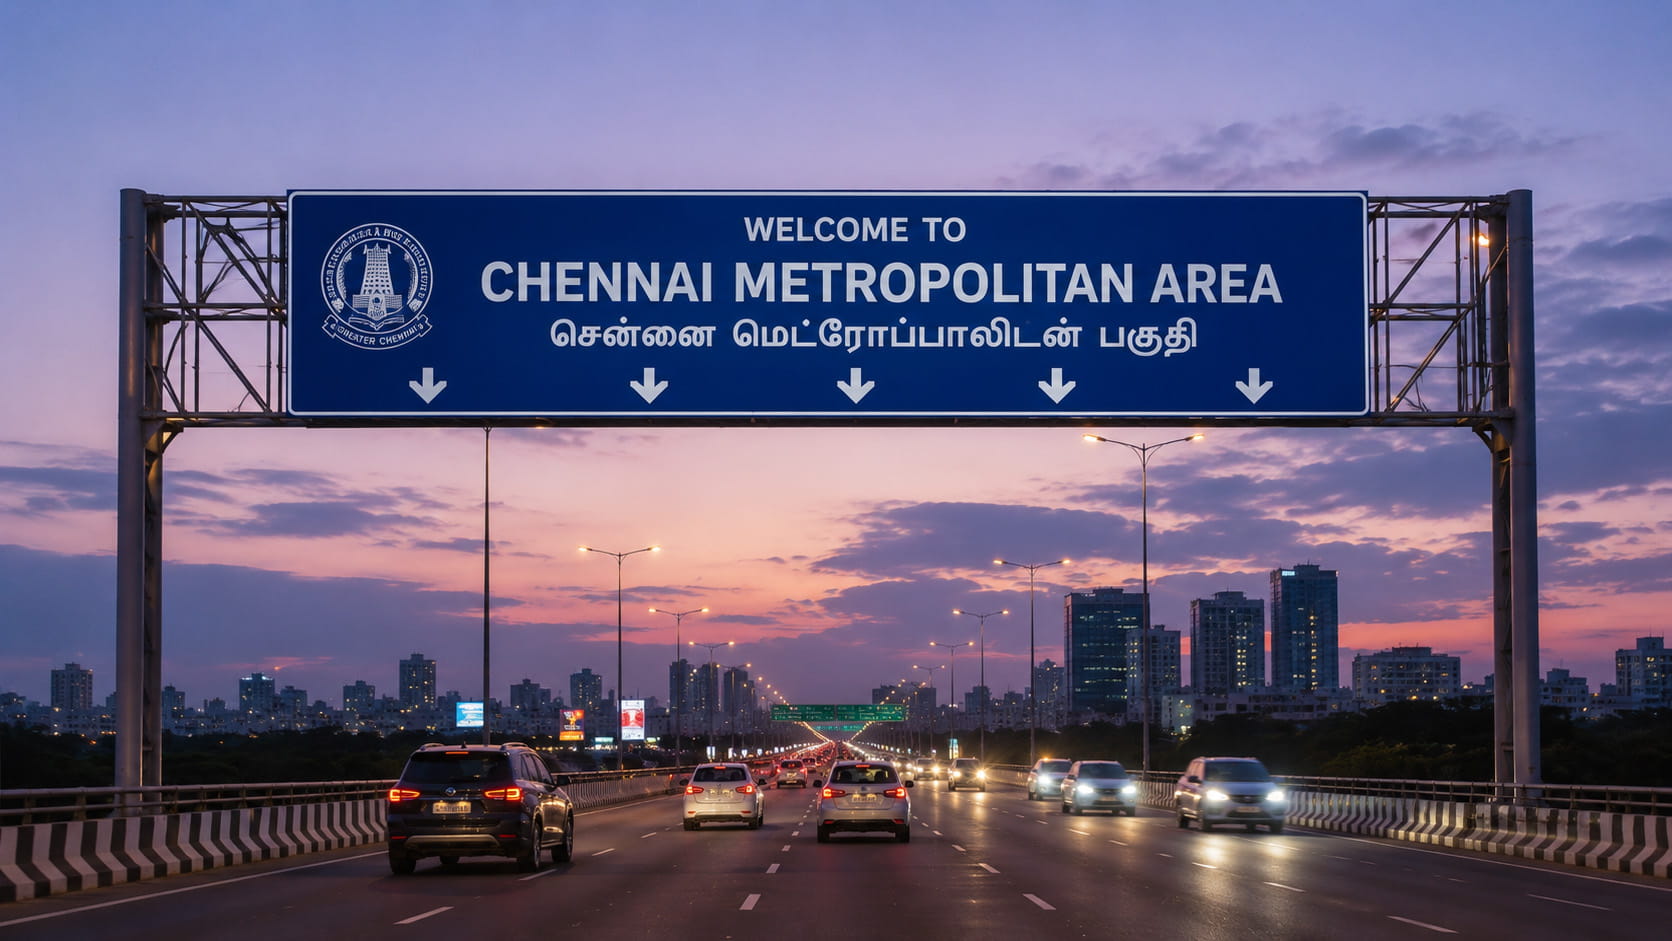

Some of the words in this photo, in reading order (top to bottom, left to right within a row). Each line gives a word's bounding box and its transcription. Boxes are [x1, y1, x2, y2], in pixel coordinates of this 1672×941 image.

[744, 216, 908, 242] WELCOME
[922, 216, 967, 242] TO
[481, 261, 712, 303] CHENNAI
[736, 262, 1133, 303] METROPOLITAN
[1151, 263, 1283, 304] AREA
[550, 316, 717, 347] சென்னை
[732, 316, 1083, 354] மெட்ரோப்பாலிடன்
[1099, 316, 1197, 357] பகுதி
